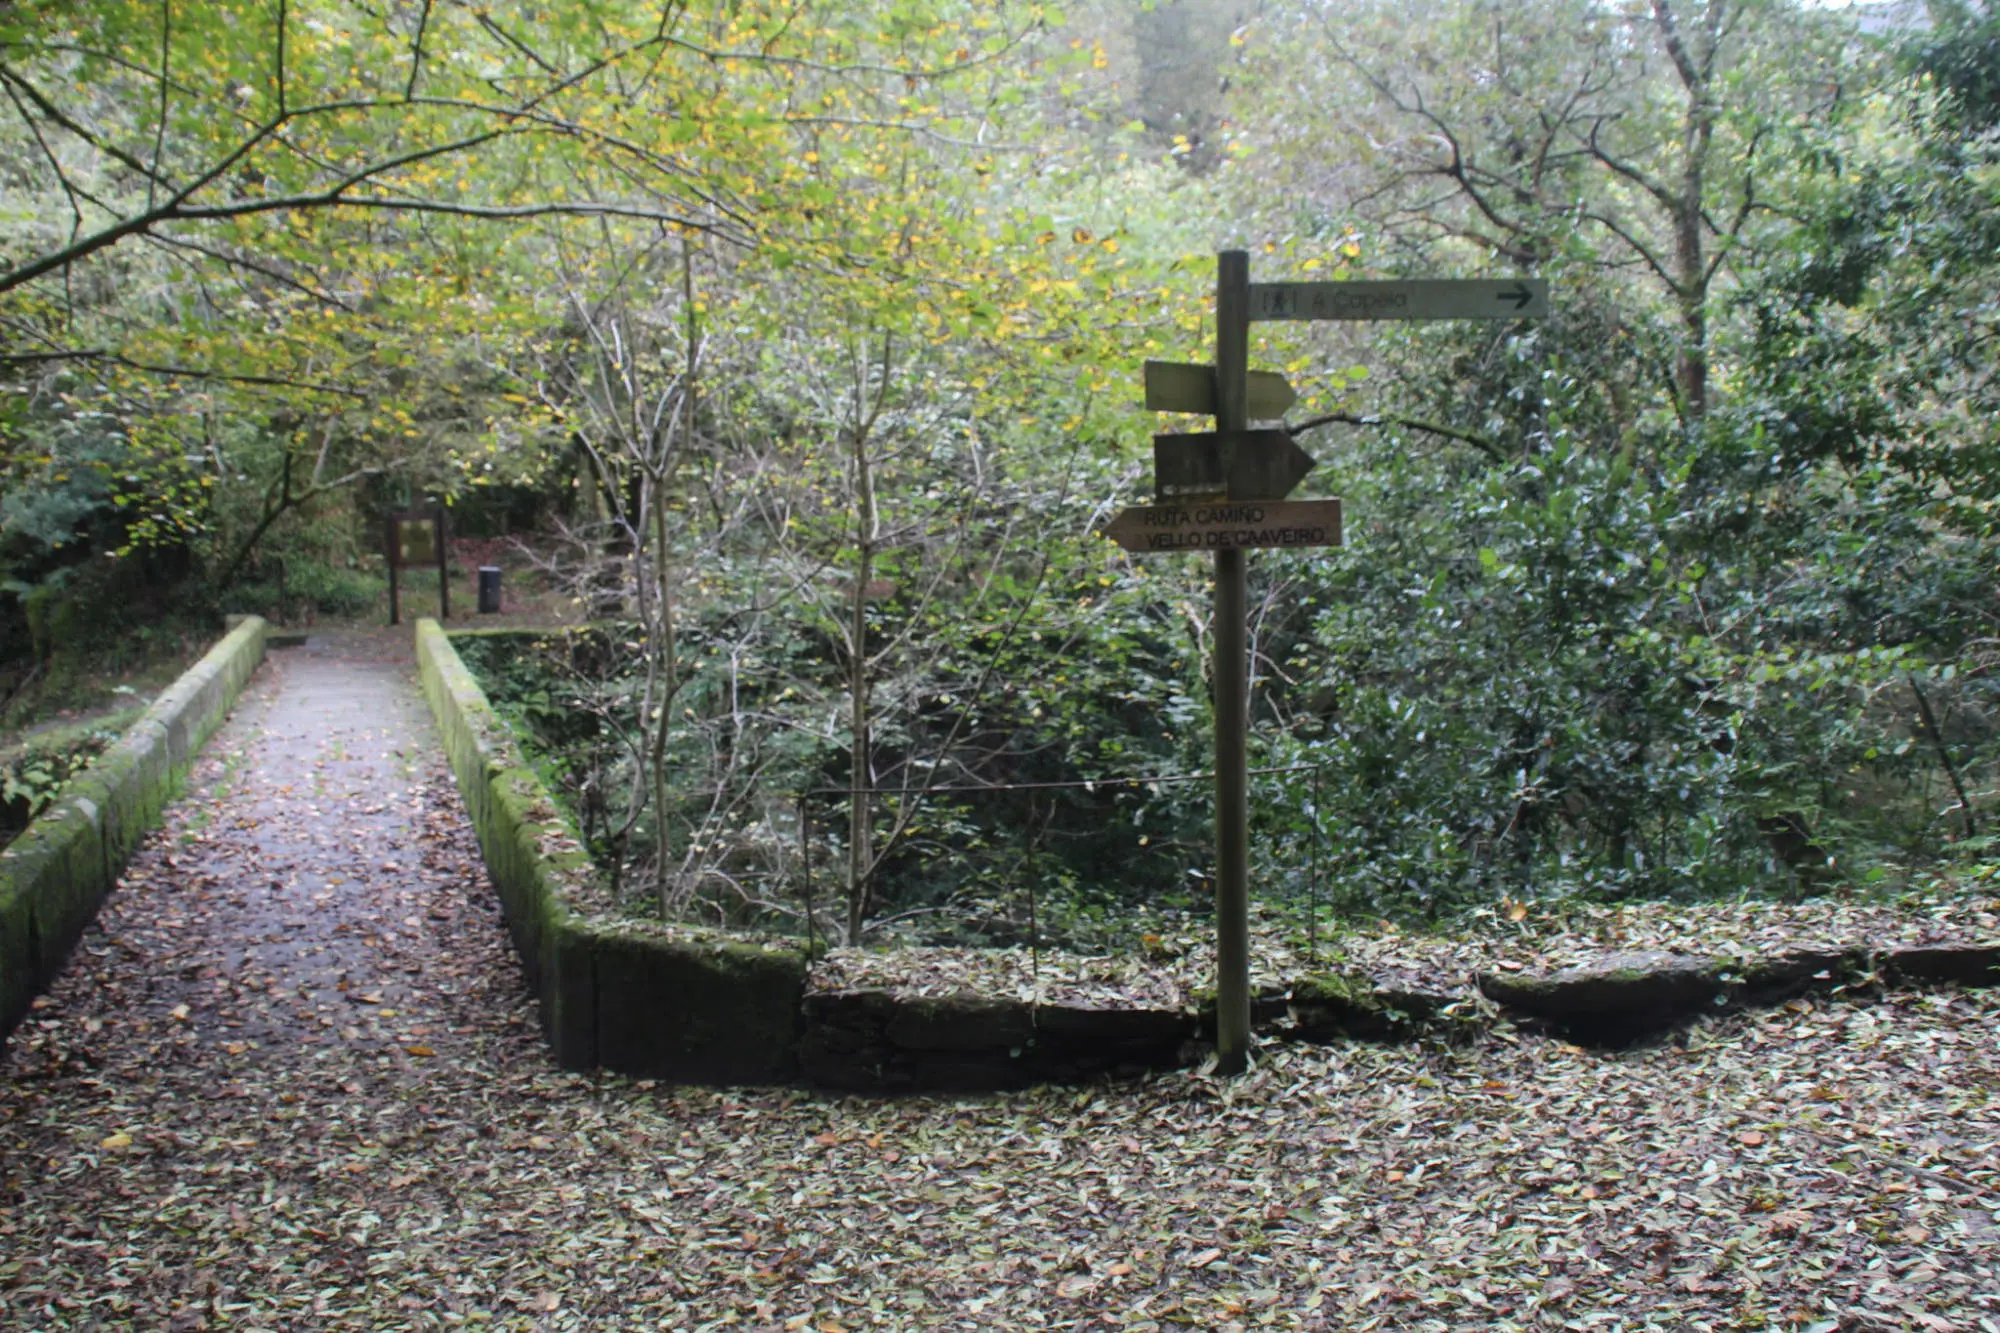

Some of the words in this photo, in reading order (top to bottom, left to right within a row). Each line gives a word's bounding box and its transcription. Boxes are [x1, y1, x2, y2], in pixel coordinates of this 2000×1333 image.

[1144, 510, 1191, 527] RUTA
[1196, 507, 1265, 524] CAMIÑO
[1147, 531, 1201, 548] VELLO
[1207, 530, 1231, 546] DE
[1235, 527, 1325, 545] CAAVEIRO
